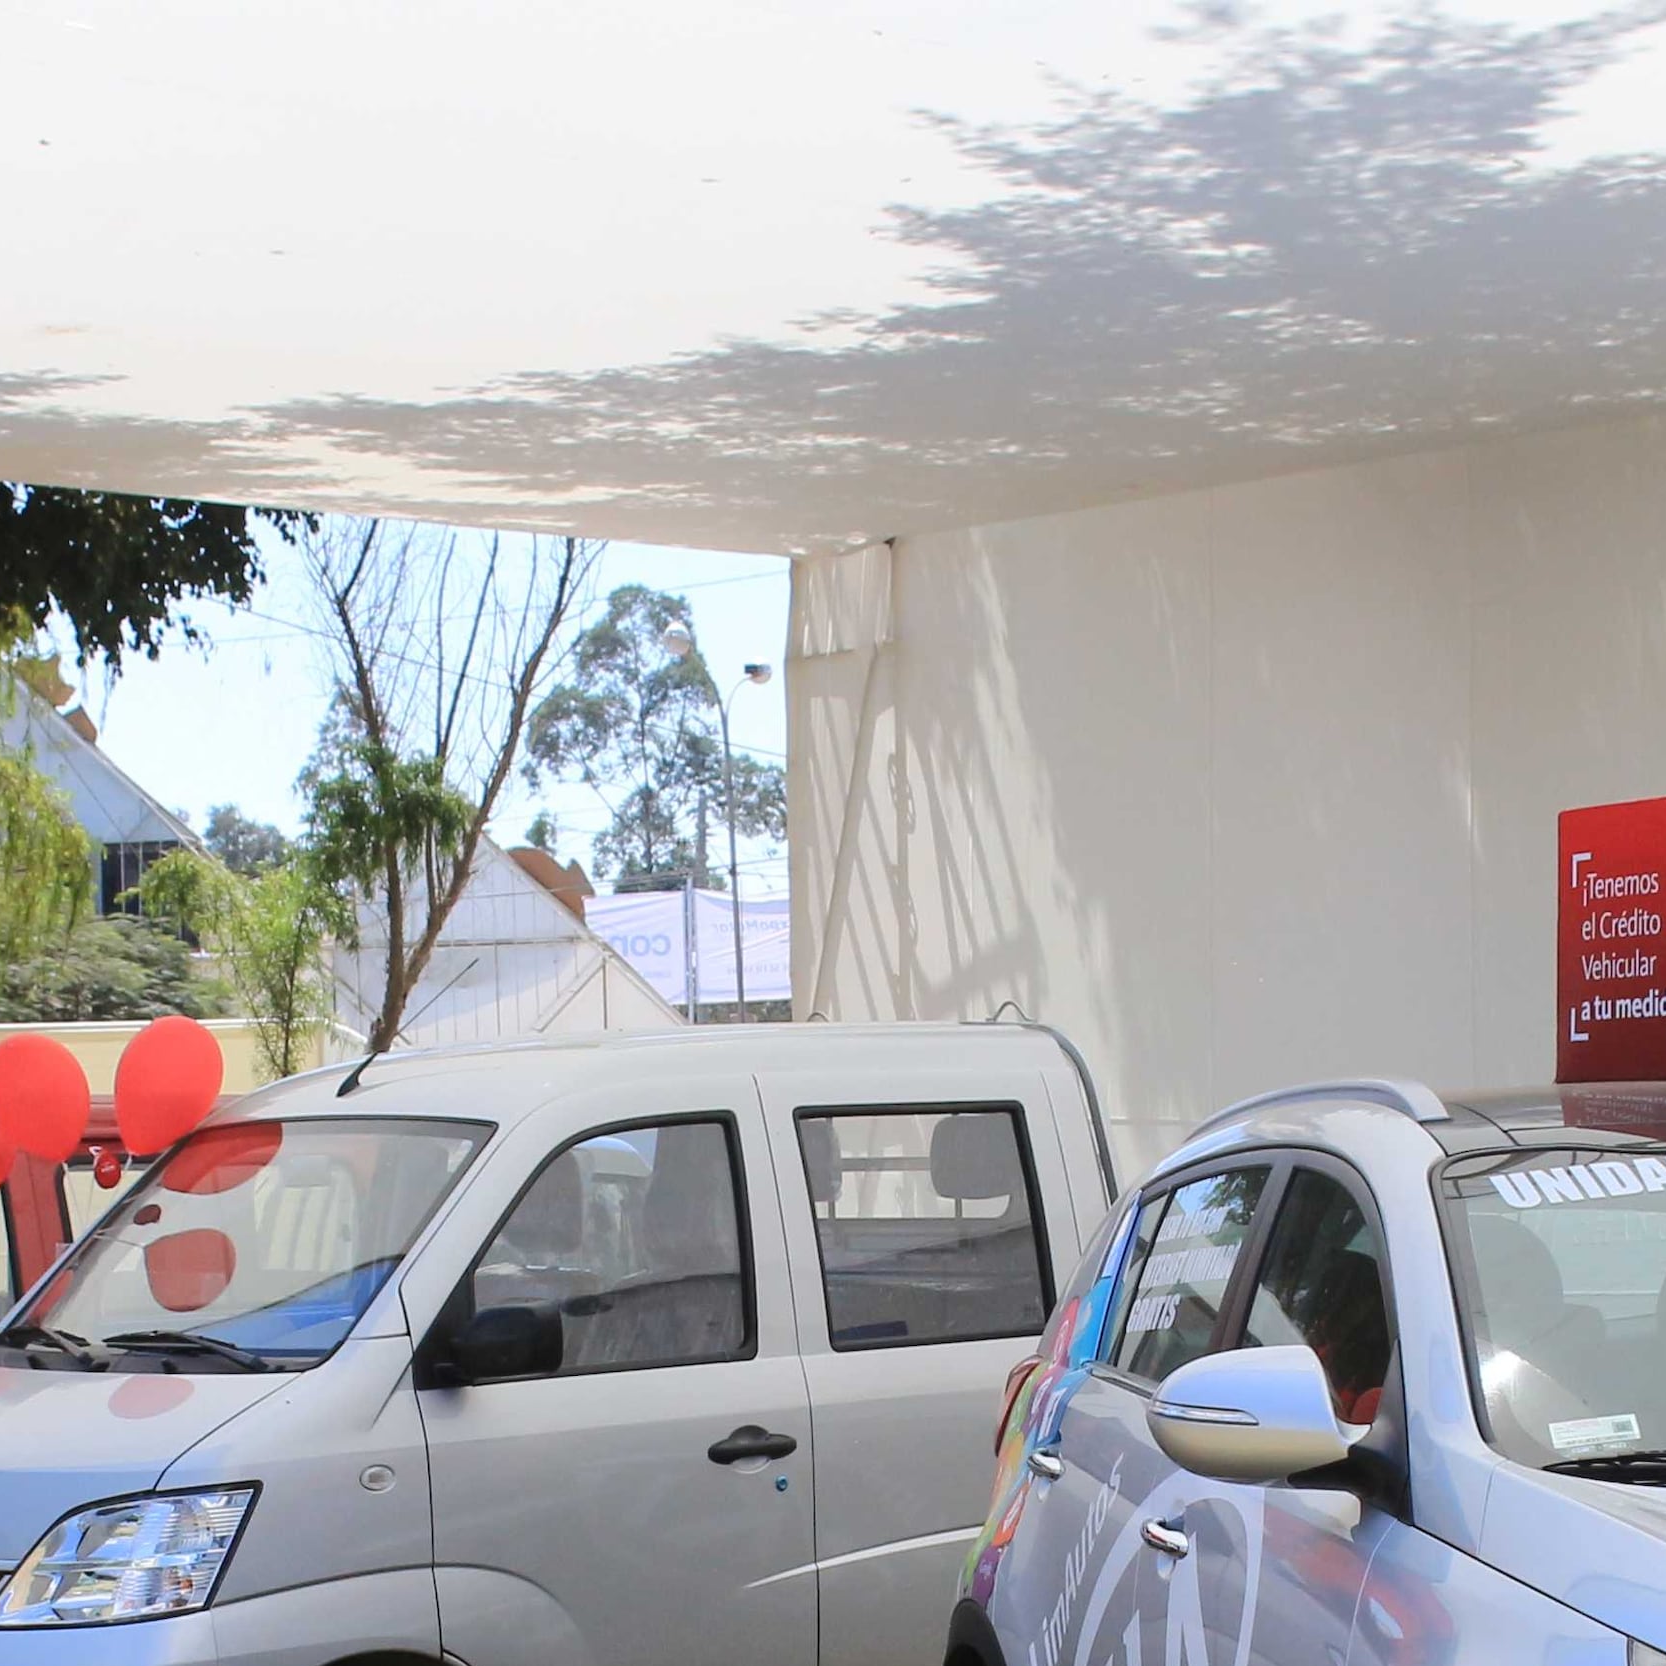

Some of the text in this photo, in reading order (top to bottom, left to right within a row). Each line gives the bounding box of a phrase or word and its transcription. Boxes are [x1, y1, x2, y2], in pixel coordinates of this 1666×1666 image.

[1583, 872, 1660, 907] ¡Tenemos
[1581, 907, 1662, 941] el Crédito
[1581, 948, 1658, 981] Vehicular
[1580, 1000, 1591, 1022] a
[1594, 995, 1612, 1021] tu
